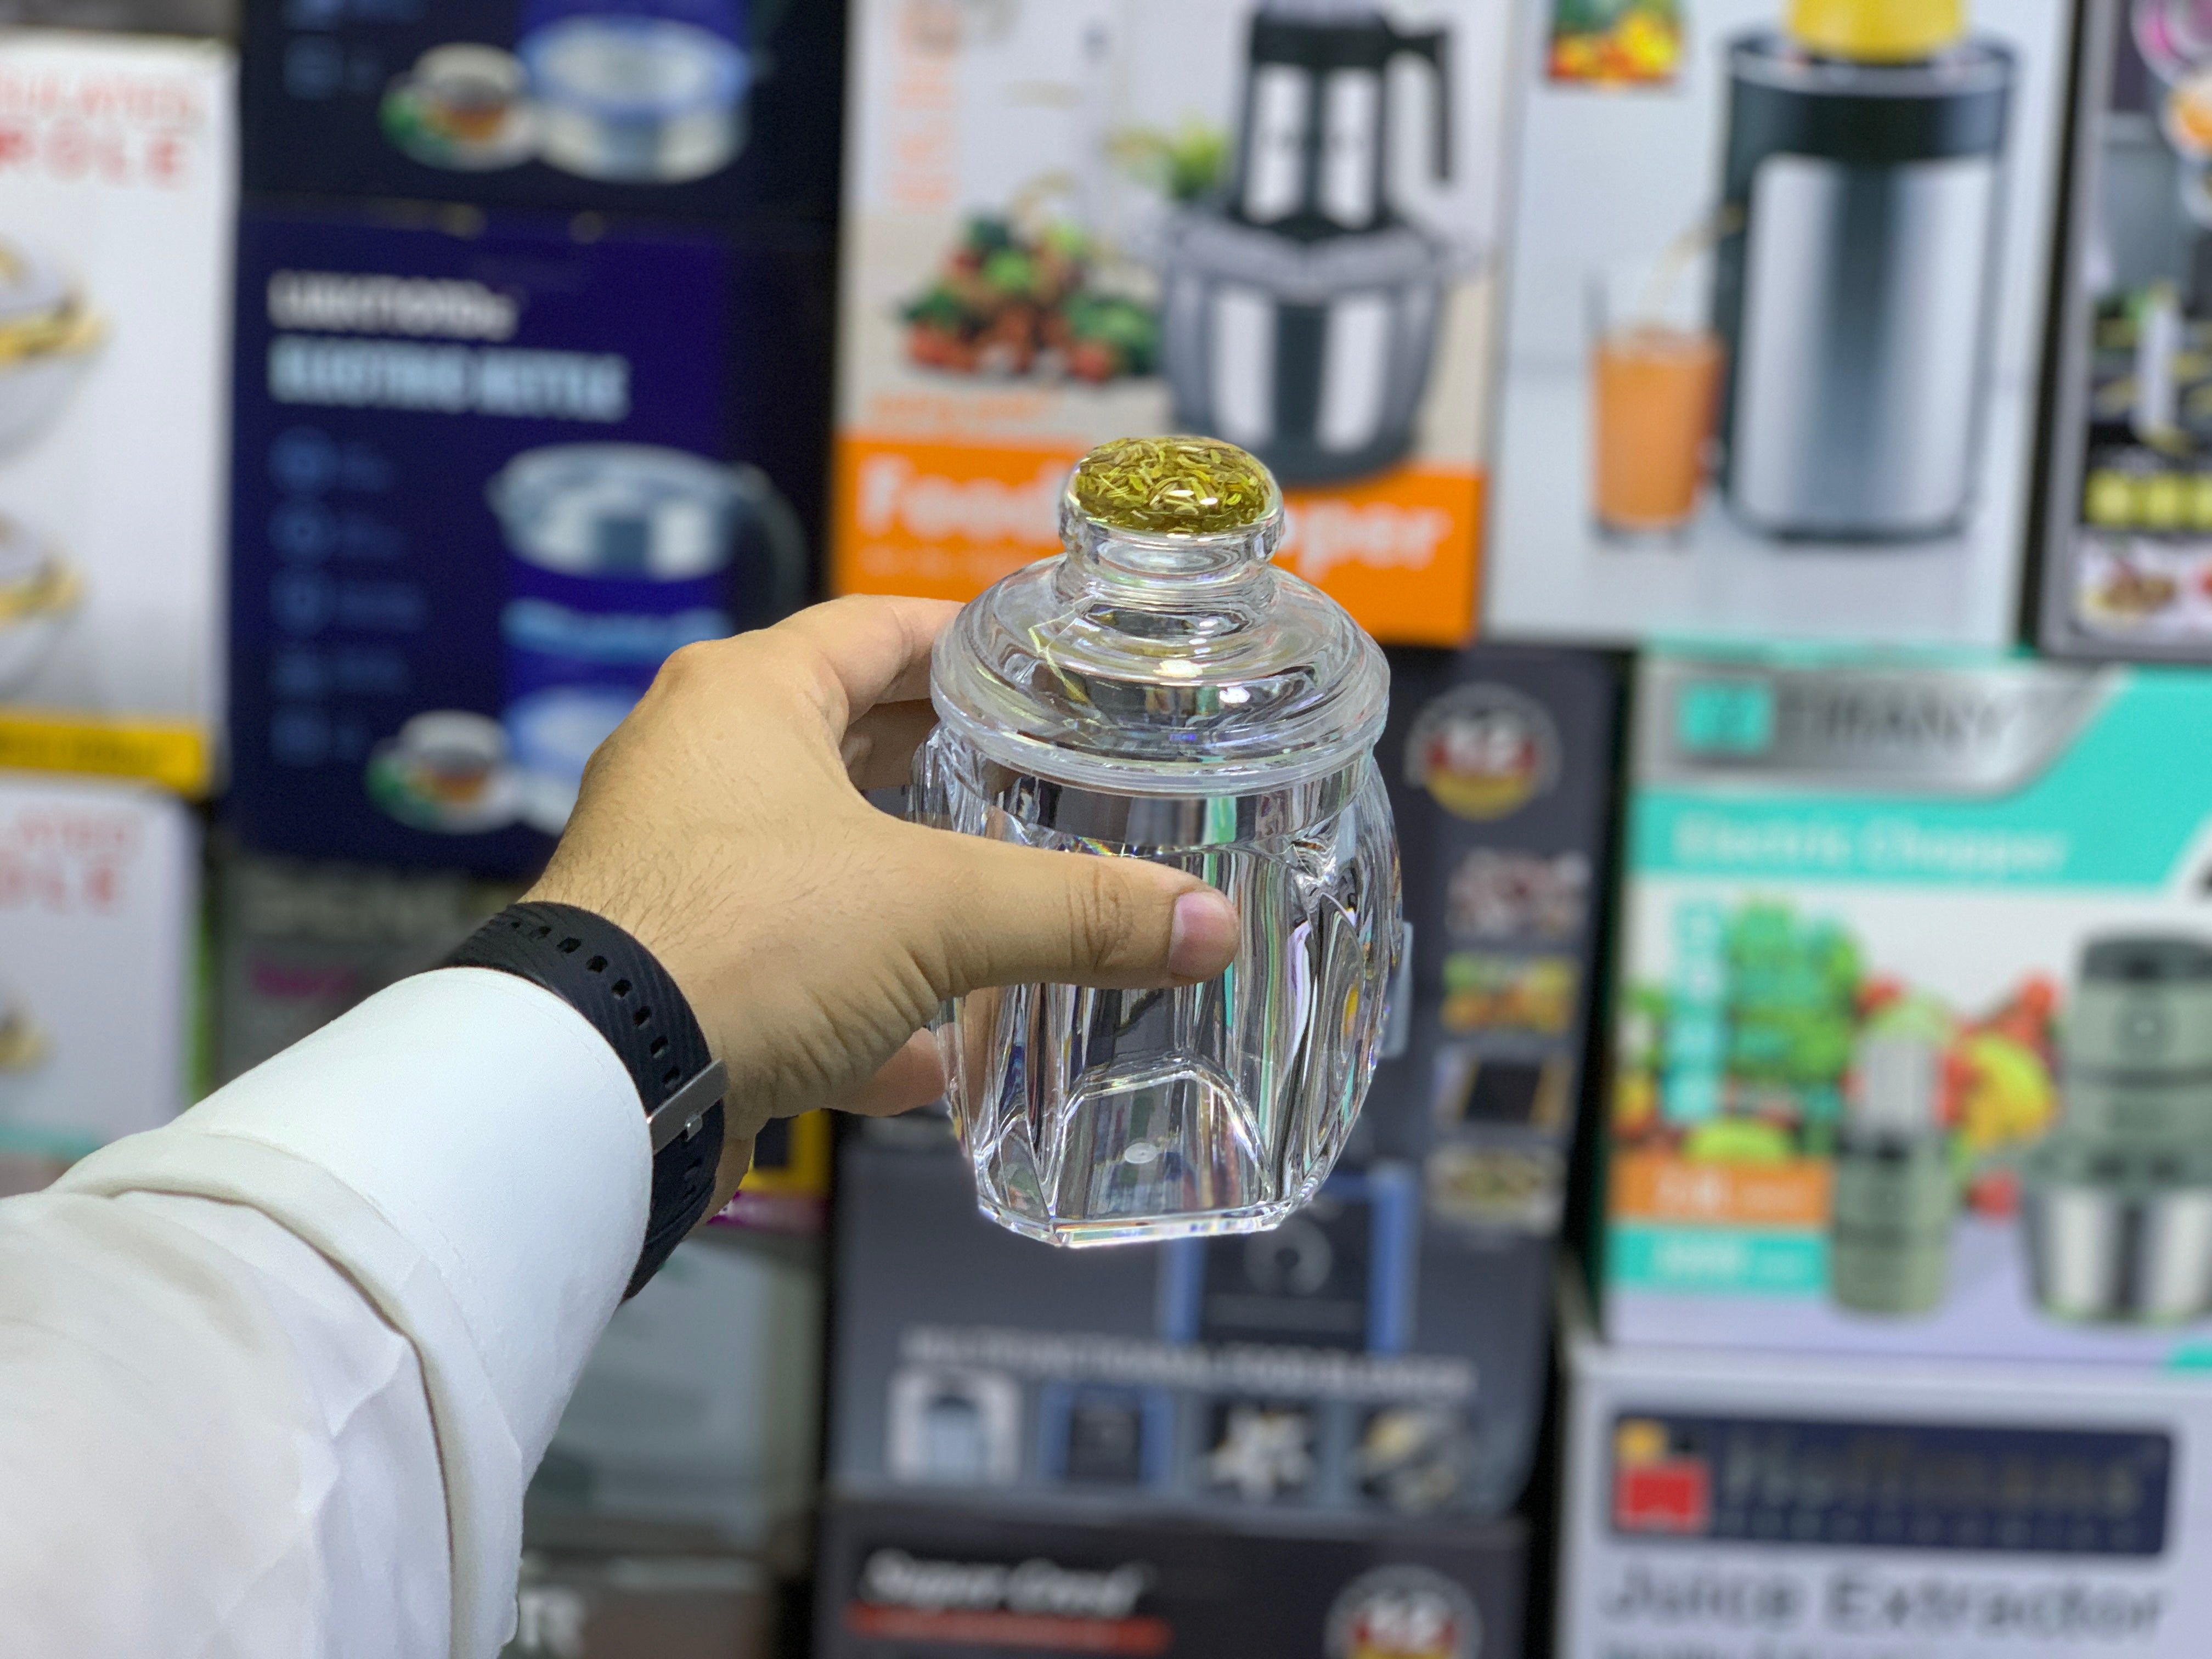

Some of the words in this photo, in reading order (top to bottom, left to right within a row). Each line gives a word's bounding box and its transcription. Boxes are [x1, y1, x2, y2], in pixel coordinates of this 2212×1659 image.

[1285, 500, 1448, 579] per
[1673, 813, 1855, 864] Electric
[1862, 819, 2069, 877] Chopper
[1601, 1564, 1803, 1626] Juice
[1826, 1567, 2167, 1639] Extractor
